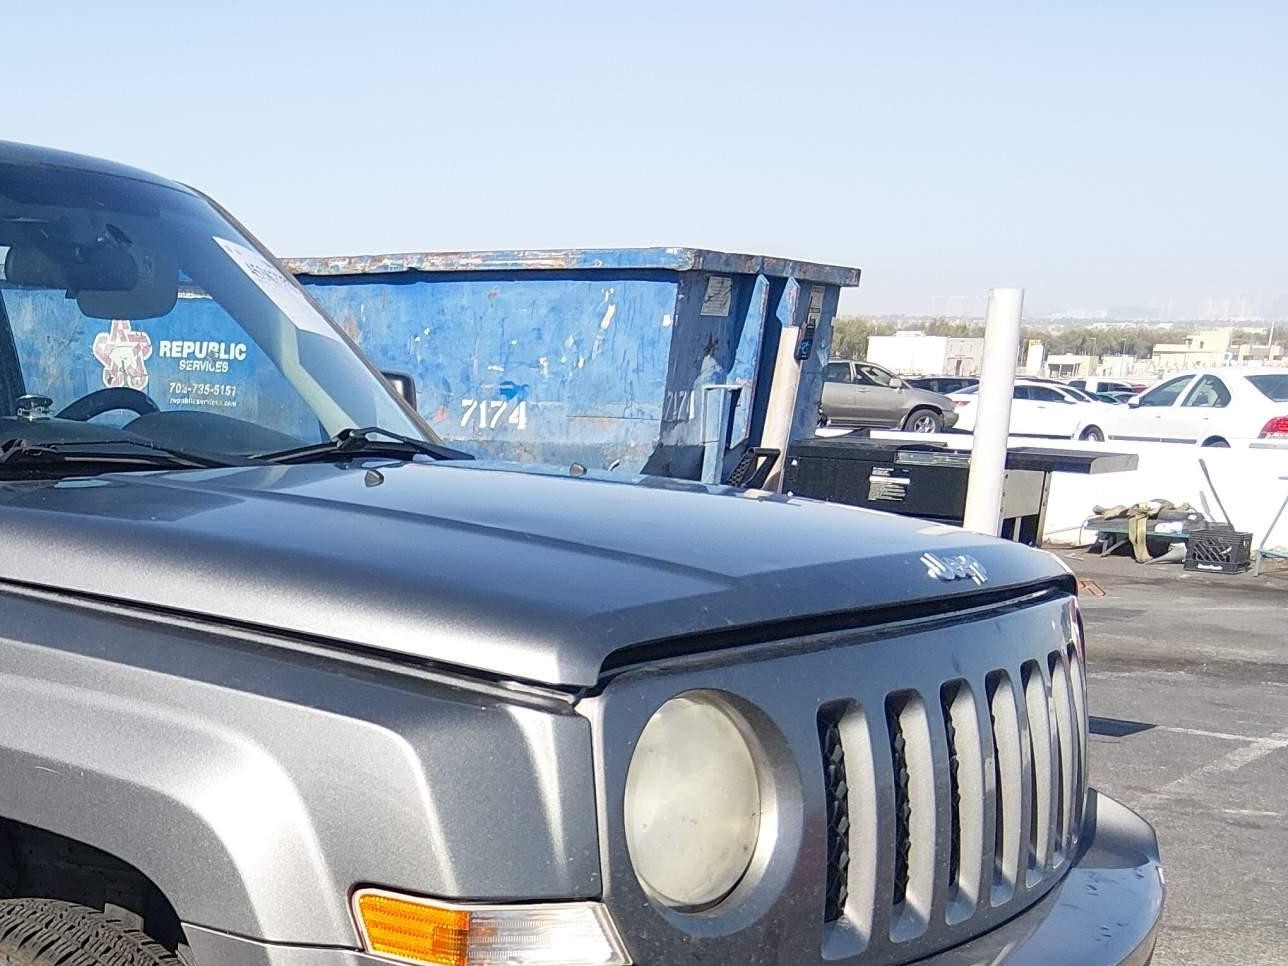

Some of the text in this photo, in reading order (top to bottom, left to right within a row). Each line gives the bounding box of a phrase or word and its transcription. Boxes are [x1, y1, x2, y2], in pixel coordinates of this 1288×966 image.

[159, 340, 248, 361] REPUBLIC
[179, 359, 229, 373] SERVICES
[460, 398, 528, 431] 7174
